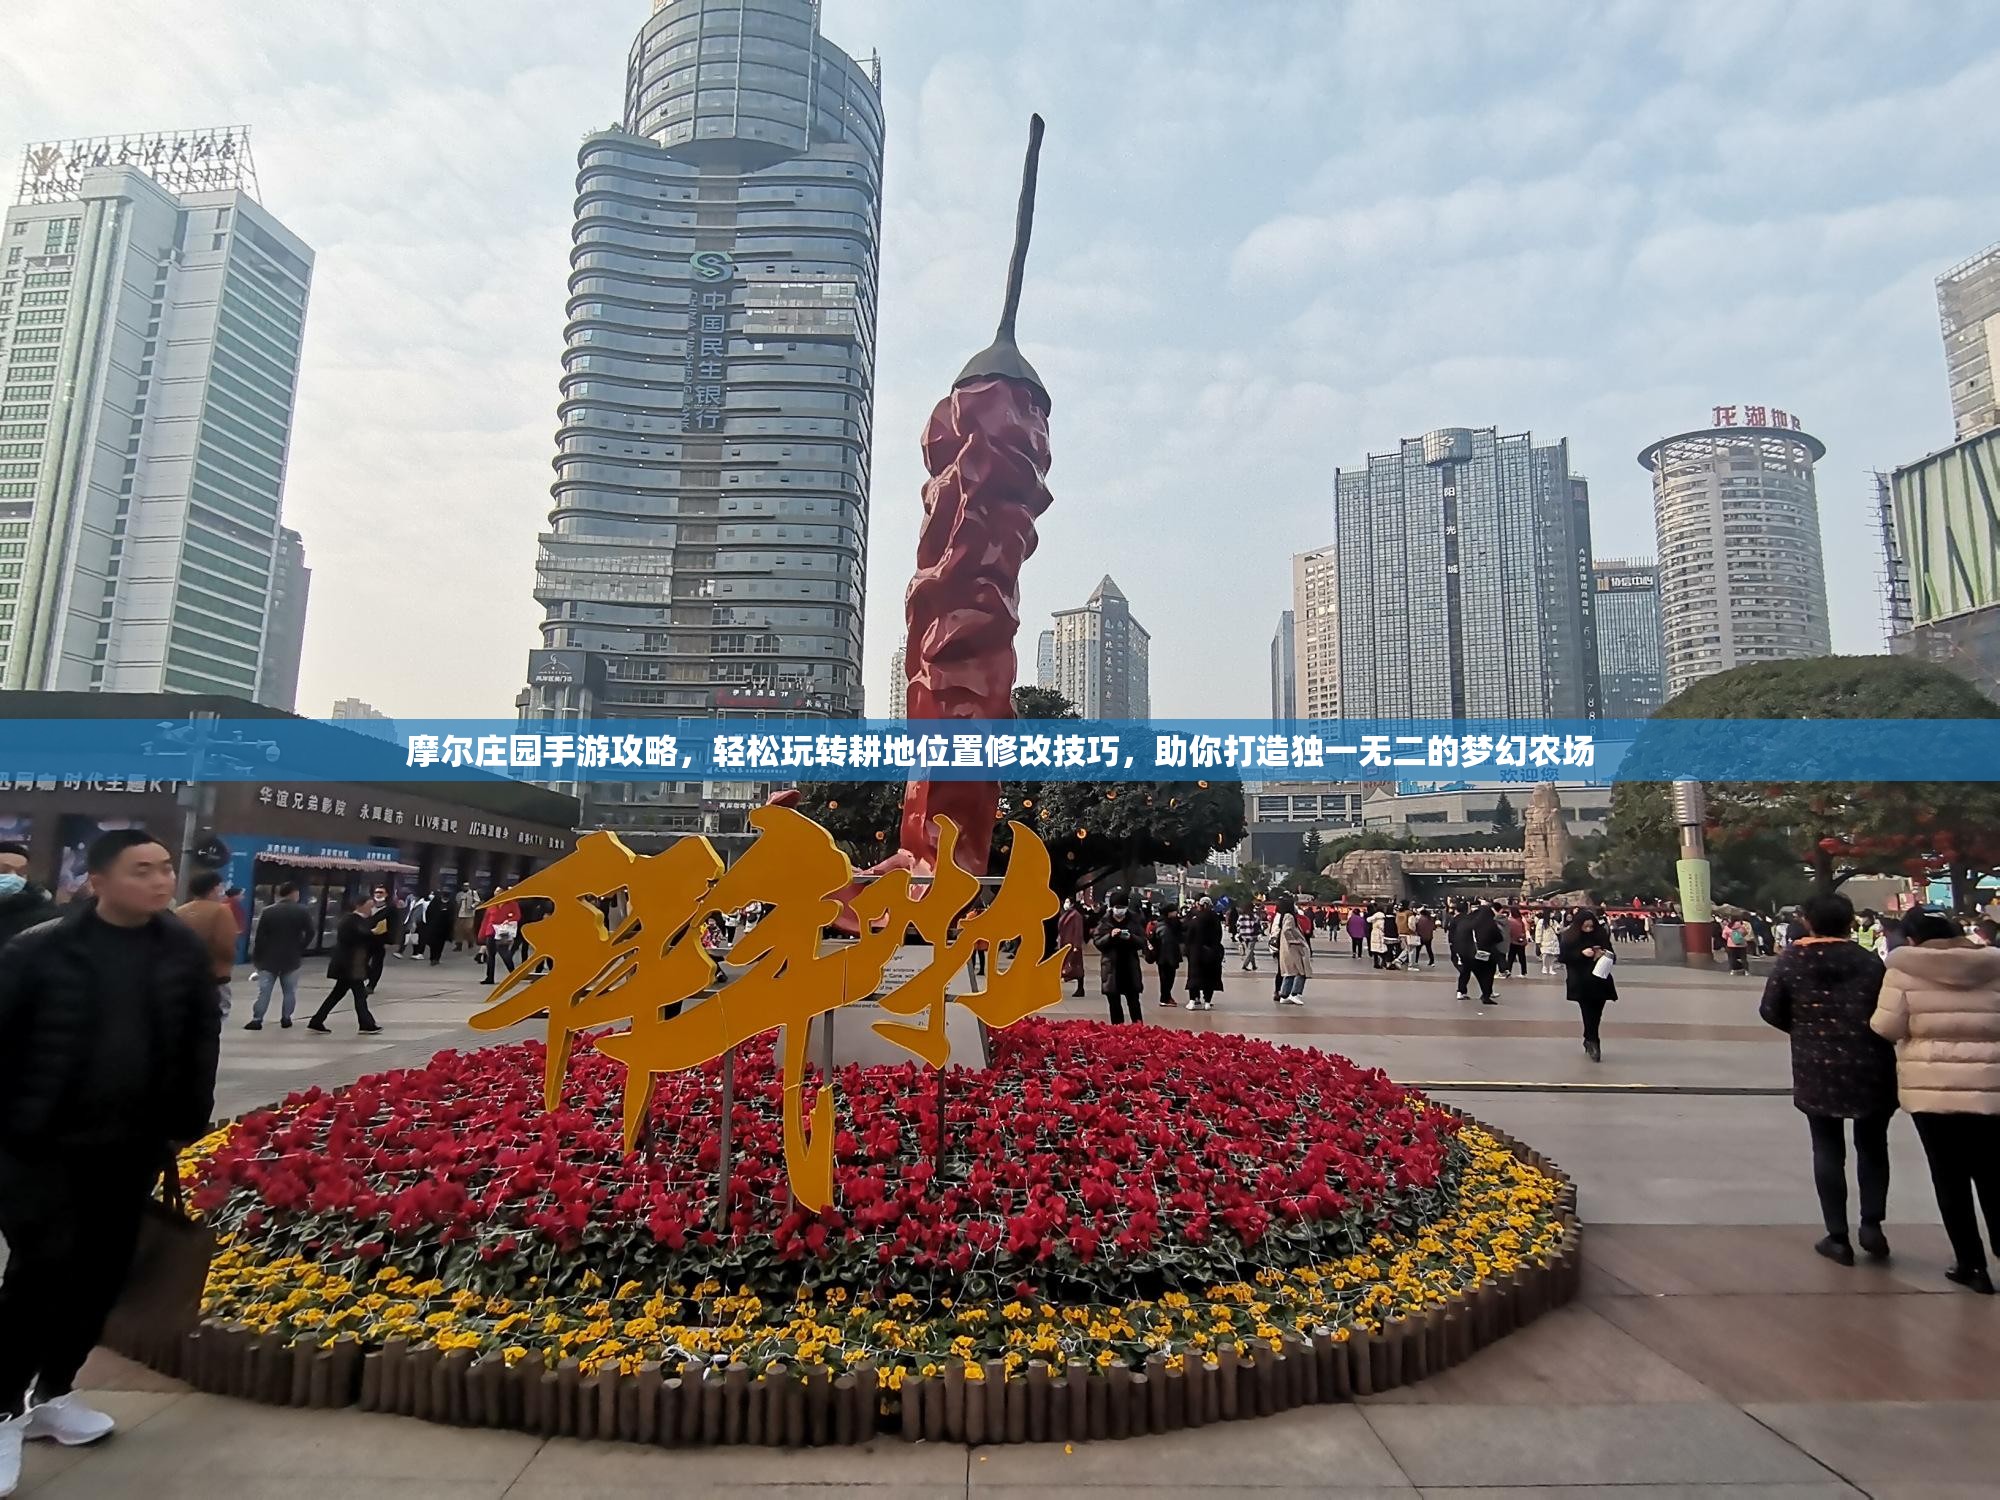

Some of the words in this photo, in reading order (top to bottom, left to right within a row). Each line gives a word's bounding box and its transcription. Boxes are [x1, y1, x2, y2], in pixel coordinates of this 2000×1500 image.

[688, 292, 698, 330] CHINA
[683, 331, 695, 393] MINSHENG
[695, 291, 726, 429] 中国民生银行
[1444, 487, 1459, 574] 阳光城
[1611, 575, 1654, 587] 协信中心
[1499, 767, 1560, 784] 欢迎您
[259, 785, 347, 817] 华谊兄弟影院
[359, 803, 405, 825] 永辉超市
